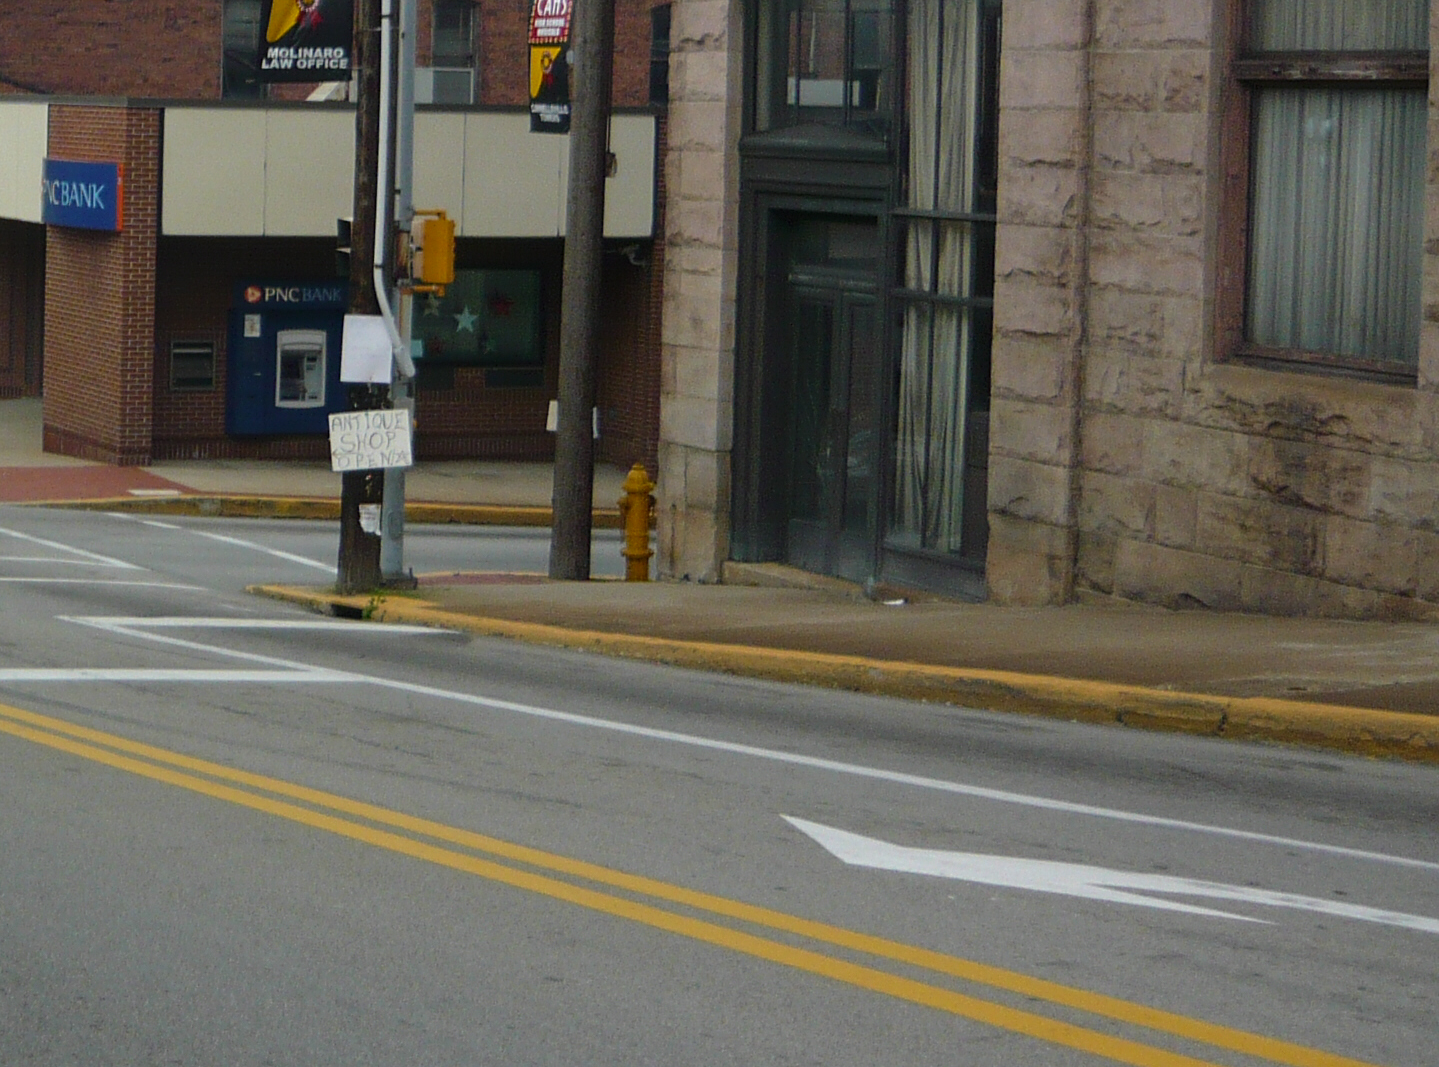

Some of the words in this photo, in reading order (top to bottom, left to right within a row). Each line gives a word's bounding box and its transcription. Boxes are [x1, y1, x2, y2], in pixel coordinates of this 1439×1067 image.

[266, 46, 344, 59] MOLINARO
[261, 58, 293, 69] LAW
[296, 58, 348, 69] OFFICE
[60, 180, 105, 210] BANK
[264, 286, 300, 303] PNC
[301, 287, 342, 303] BANK
[331, 412, 407, 432] ANTIQUE
[340, 432, 397, 453] SHOP
[337, 450, 394, 469] OPEN
